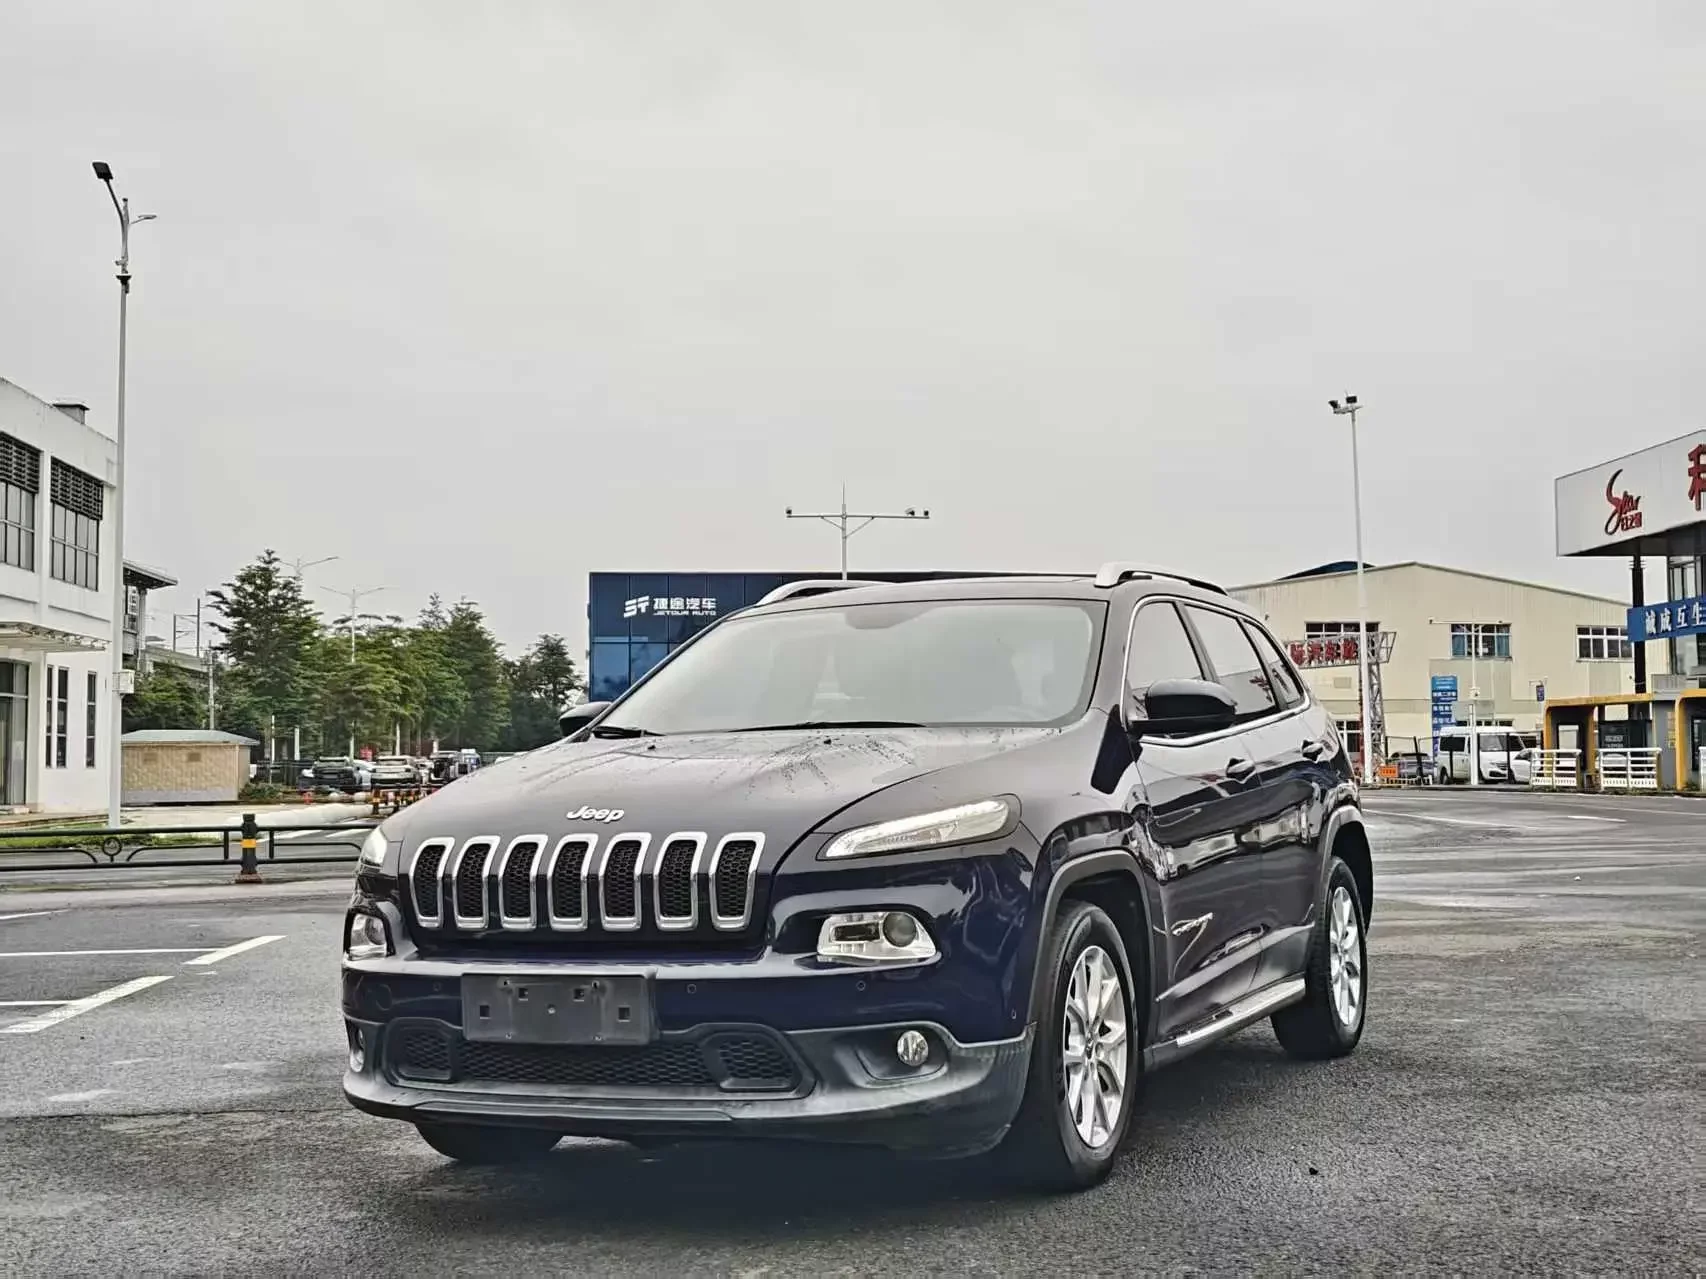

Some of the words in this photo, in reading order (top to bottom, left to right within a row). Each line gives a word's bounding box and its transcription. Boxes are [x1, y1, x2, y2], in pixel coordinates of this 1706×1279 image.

[653, 597, 717, 610] 捷途汽车
[566, 806, 625, 823] Jeep
